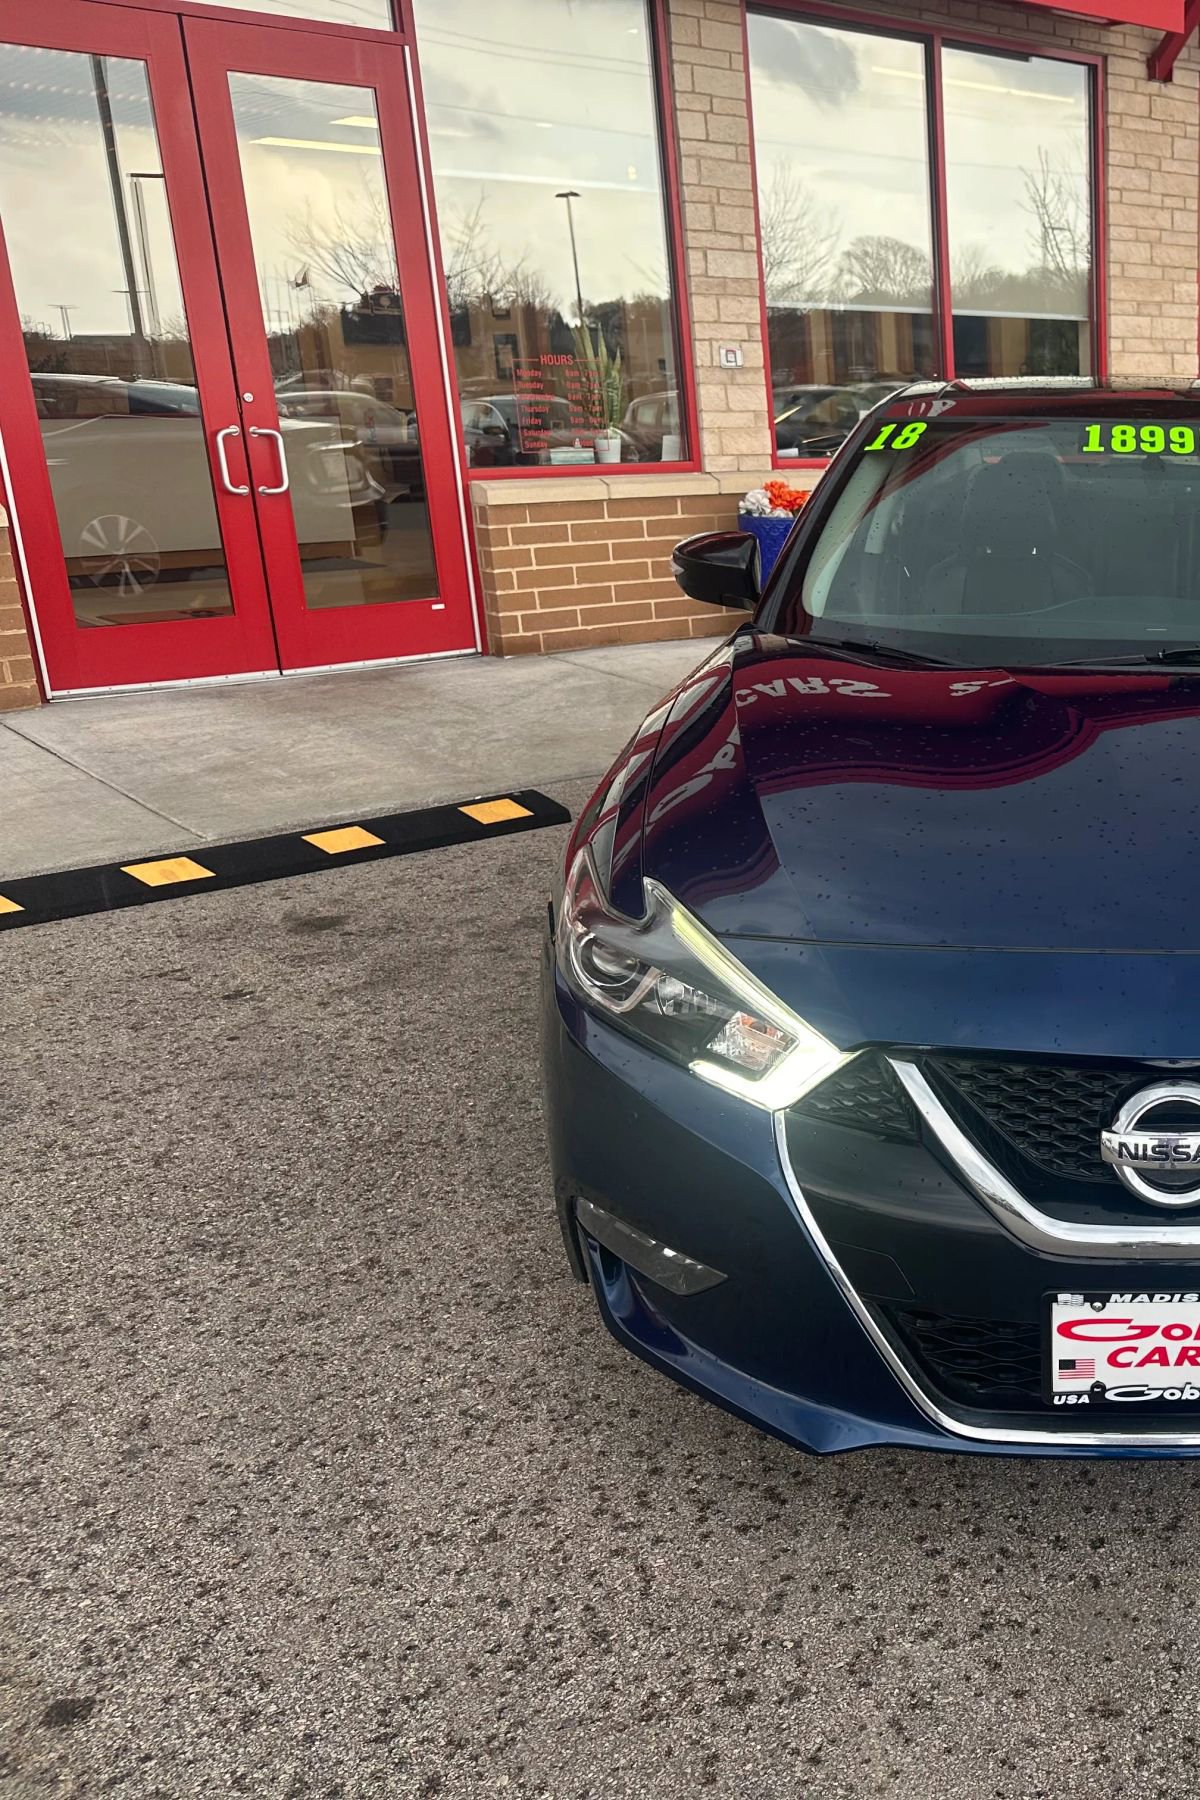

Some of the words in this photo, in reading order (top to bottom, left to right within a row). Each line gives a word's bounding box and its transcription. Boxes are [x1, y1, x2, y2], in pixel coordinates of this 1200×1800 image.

[540, 354, 574, 365] HOURS
[516, 369, 542, 378] Monday
[522, 417, 542, 425] Friday
[864, 422, 927, 451] 18
[524, 441, 548, 449] Sunday
[1053, 1393, 1090, 1405] USA
